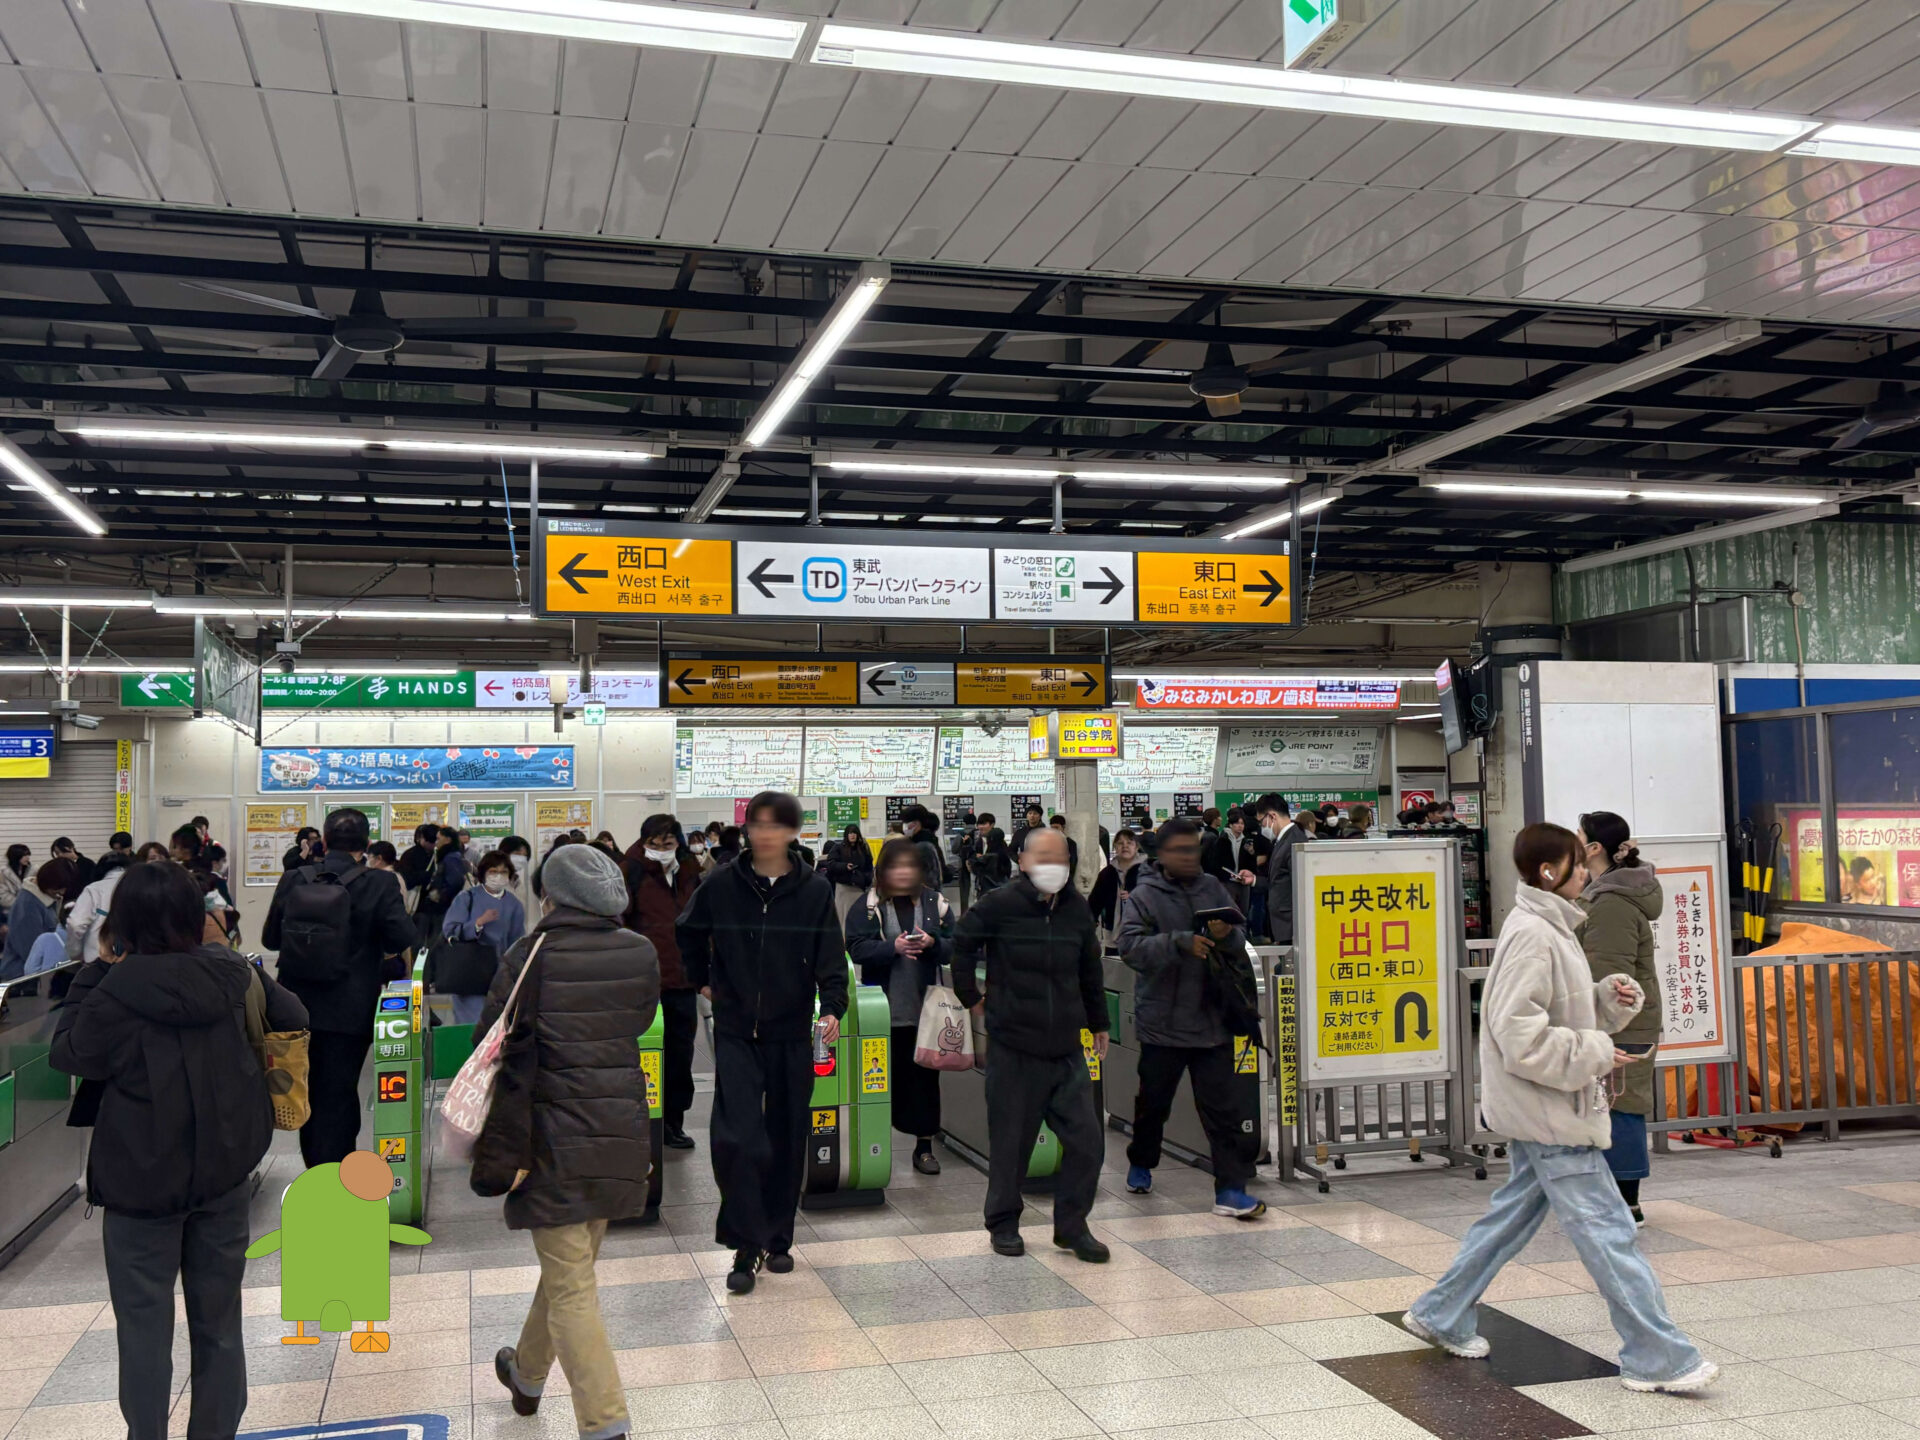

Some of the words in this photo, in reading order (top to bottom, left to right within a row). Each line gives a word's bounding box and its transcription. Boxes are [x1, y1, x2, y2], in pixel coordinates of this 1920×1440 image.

[617, 545, 667, 569] 西口
[1003, 556, 1052, 566] みどりの窓口
[853, 559, 881, 574] 東武
[1194, 560, 1236, 582] 東口
[617, 574, 657, 588] West
[662, 575, 690, 589] Exit
[810, 570, 840, 589] TD
[853, 577, 982, 594] アーバンパークライン
[1030, 580, 1052, 590] 駅たび
[618, 592, 656, 605] 西出口
[667, 593, 693, 606] 서쪽
[699, 594, 723, 606] 출구
[853, 595, 876, 604] Tobu
[879, 596, 906, 604] Urban
[908, 596, 930, 605] Park
[932, 596, 950, 605] Line
[1002, 590, 1052, 600] コンシェルジュ
[1180, 587, 1208, 599] East
[1213, 588, 1236, 600] Exit
[1146, 603, 1179, 614] 东出口
[1188, 604, 1210, 615] 동쪽
[1215, 604, 1236, 615] 출구
[712, 665, 740, 679] 西口
[1040, 668, 1066, 682] 東口
[398, 681, 468, 694] HANDS
[712, 682, 735, 690] West
[737, 682, 754, 690] Exit
[1032, 684, 1050, 692] East
[1051, 684, 1066, 692] Exit
[1164, 688, 1314, 706] みなみかしわ駅ノ歯科
[1064, 730, 1113, 742] 四谷学院
[35, 740, 48, 756] 3
[326, 752, 408, 768] 春の福島は
[326, 772, 441, 785] 見どころいっぱい!
[550, 770, 569, 781] JR
[834, 798, 854, 806] きっぷ
[1902, 863, 1920, 881] 保
[1321, 883, 1430, 914] 中央改札
[1339, 919, 1410, 959] 出口
[1690, 893, 1709, 1014] ときわ・ひたち号
[1674, 894, 1694, 1030] 特急券お買い求めの
[1330, 959, 1424, 980] (西口・東口)
[1329, 989, 1376, 1006] 南口は
[1666, 962, 1682, 1034] お客さまへ
[1322, 1010, 1384, 1028] 反対です
[378, 1020, 408, 1040] IC
[1333, 1030, 1373, 1041] 連絡通路を
[1704, 1030, 1715, 1040] JR
[380, 1043, 406, 1057] 専用
[1280, 977, 1297, 1124] 自動改札機付近防犯カメラ作動中
[1328, 1041, 1378, 1052] ご利用ください
[1246, 1122, 1251, 1130] 5
[1040, 1135, 1044, 1143] 6
[822, 1149, 828, 1158] 7
[872, 1146, 878, 1154] 6
[394, 1178, 402, 1187] 8
